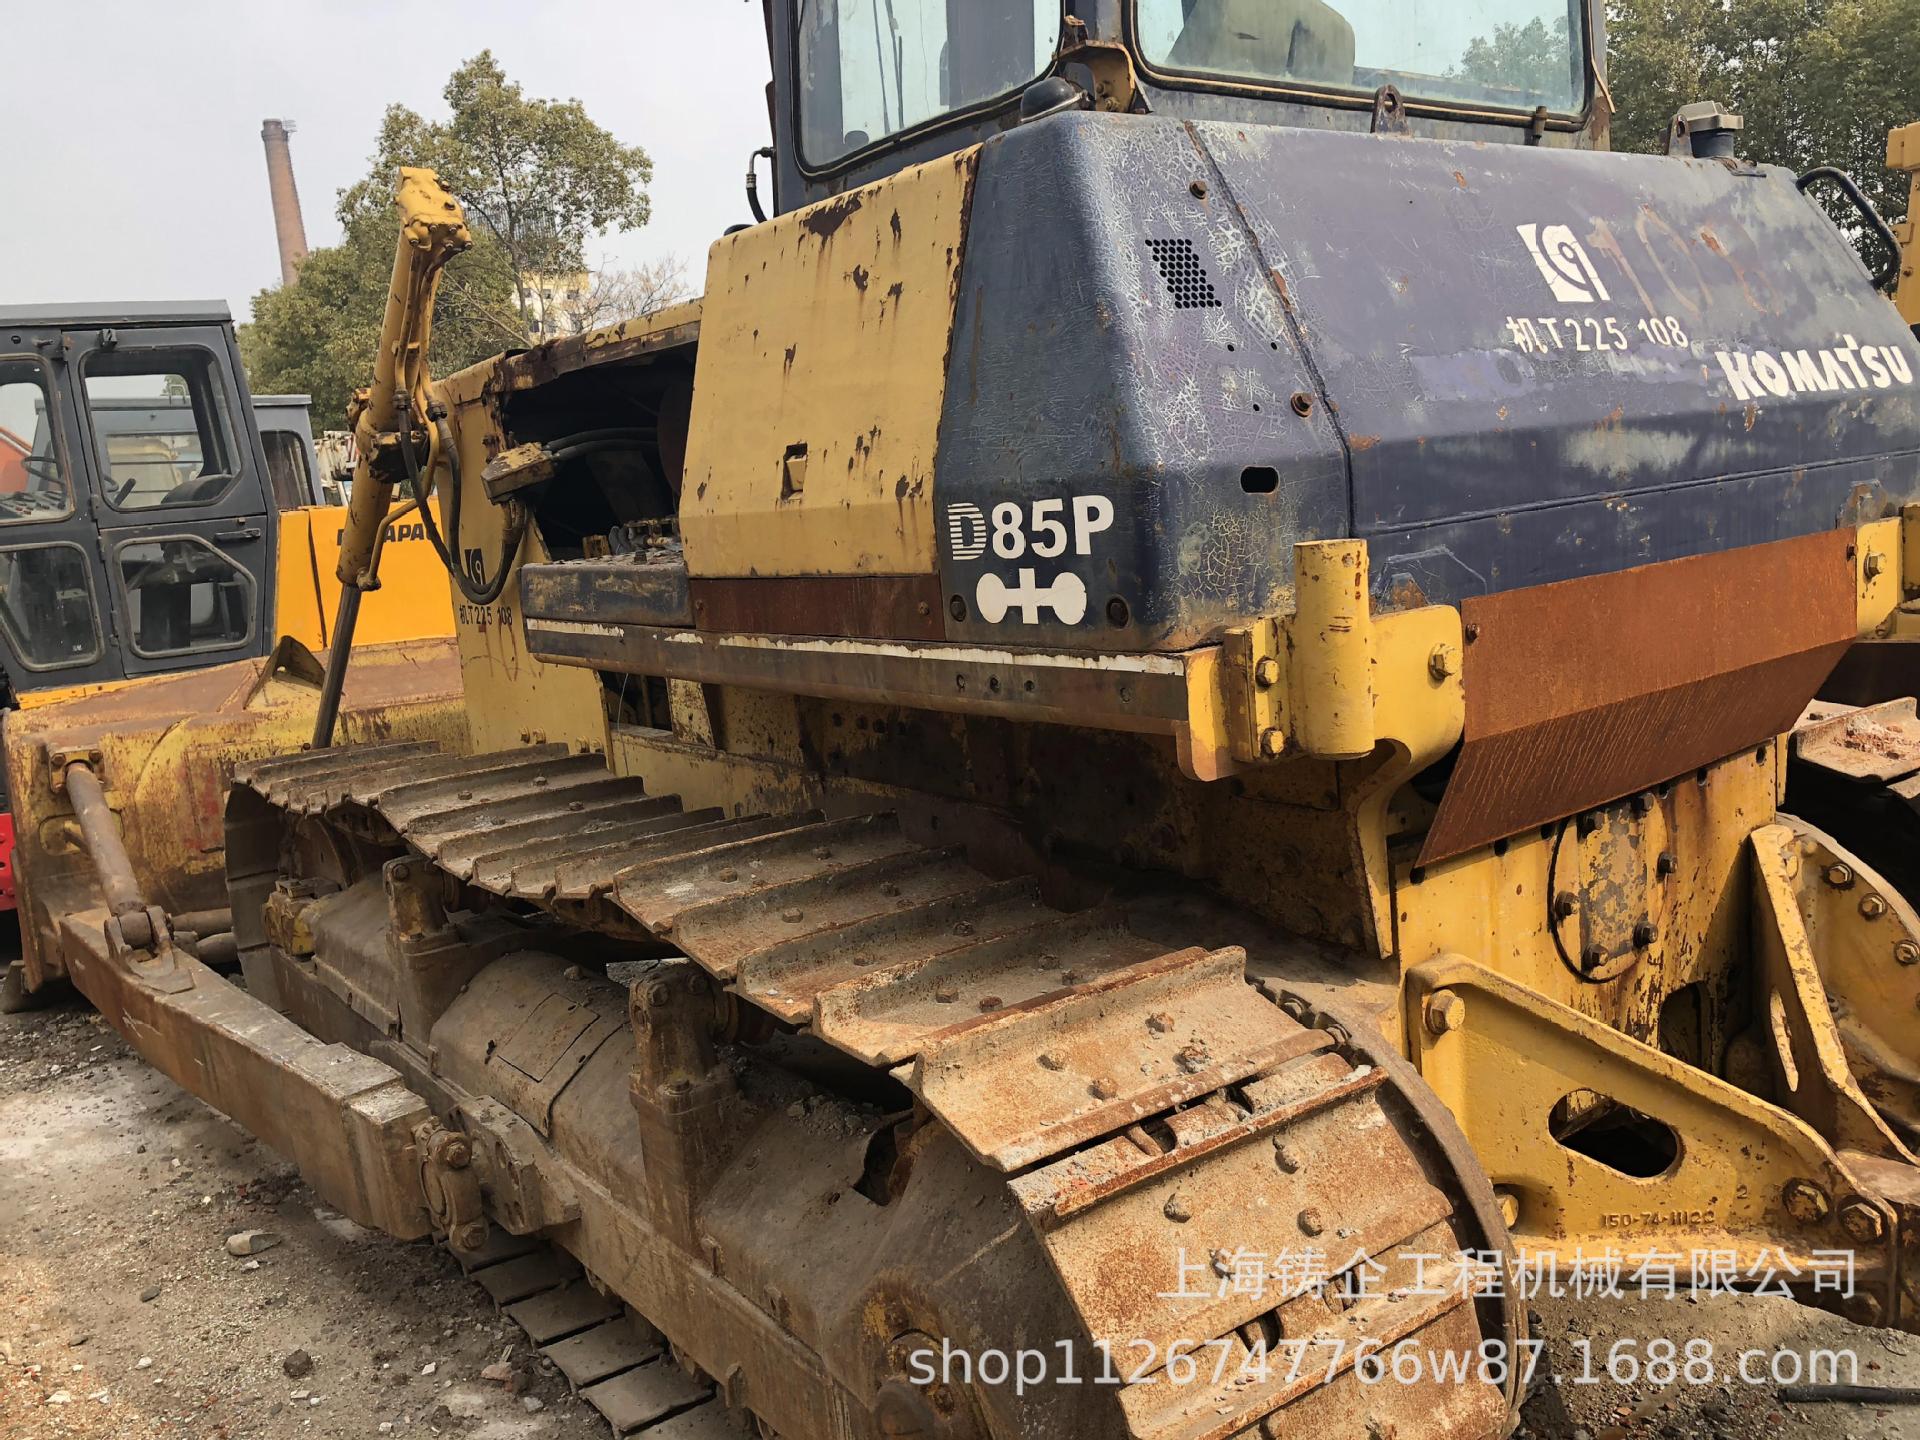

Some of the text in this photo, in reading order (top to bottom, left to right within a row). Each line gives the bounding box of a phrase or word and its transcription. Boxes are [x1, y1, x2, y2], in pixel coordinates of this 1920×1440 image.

[1638, 315, 1690, 348] 108
[1714, 334, 1914, 401] KOMATSU
[947, 495, 1115, 561] D85P
[497, 606, 513, 626] 108
